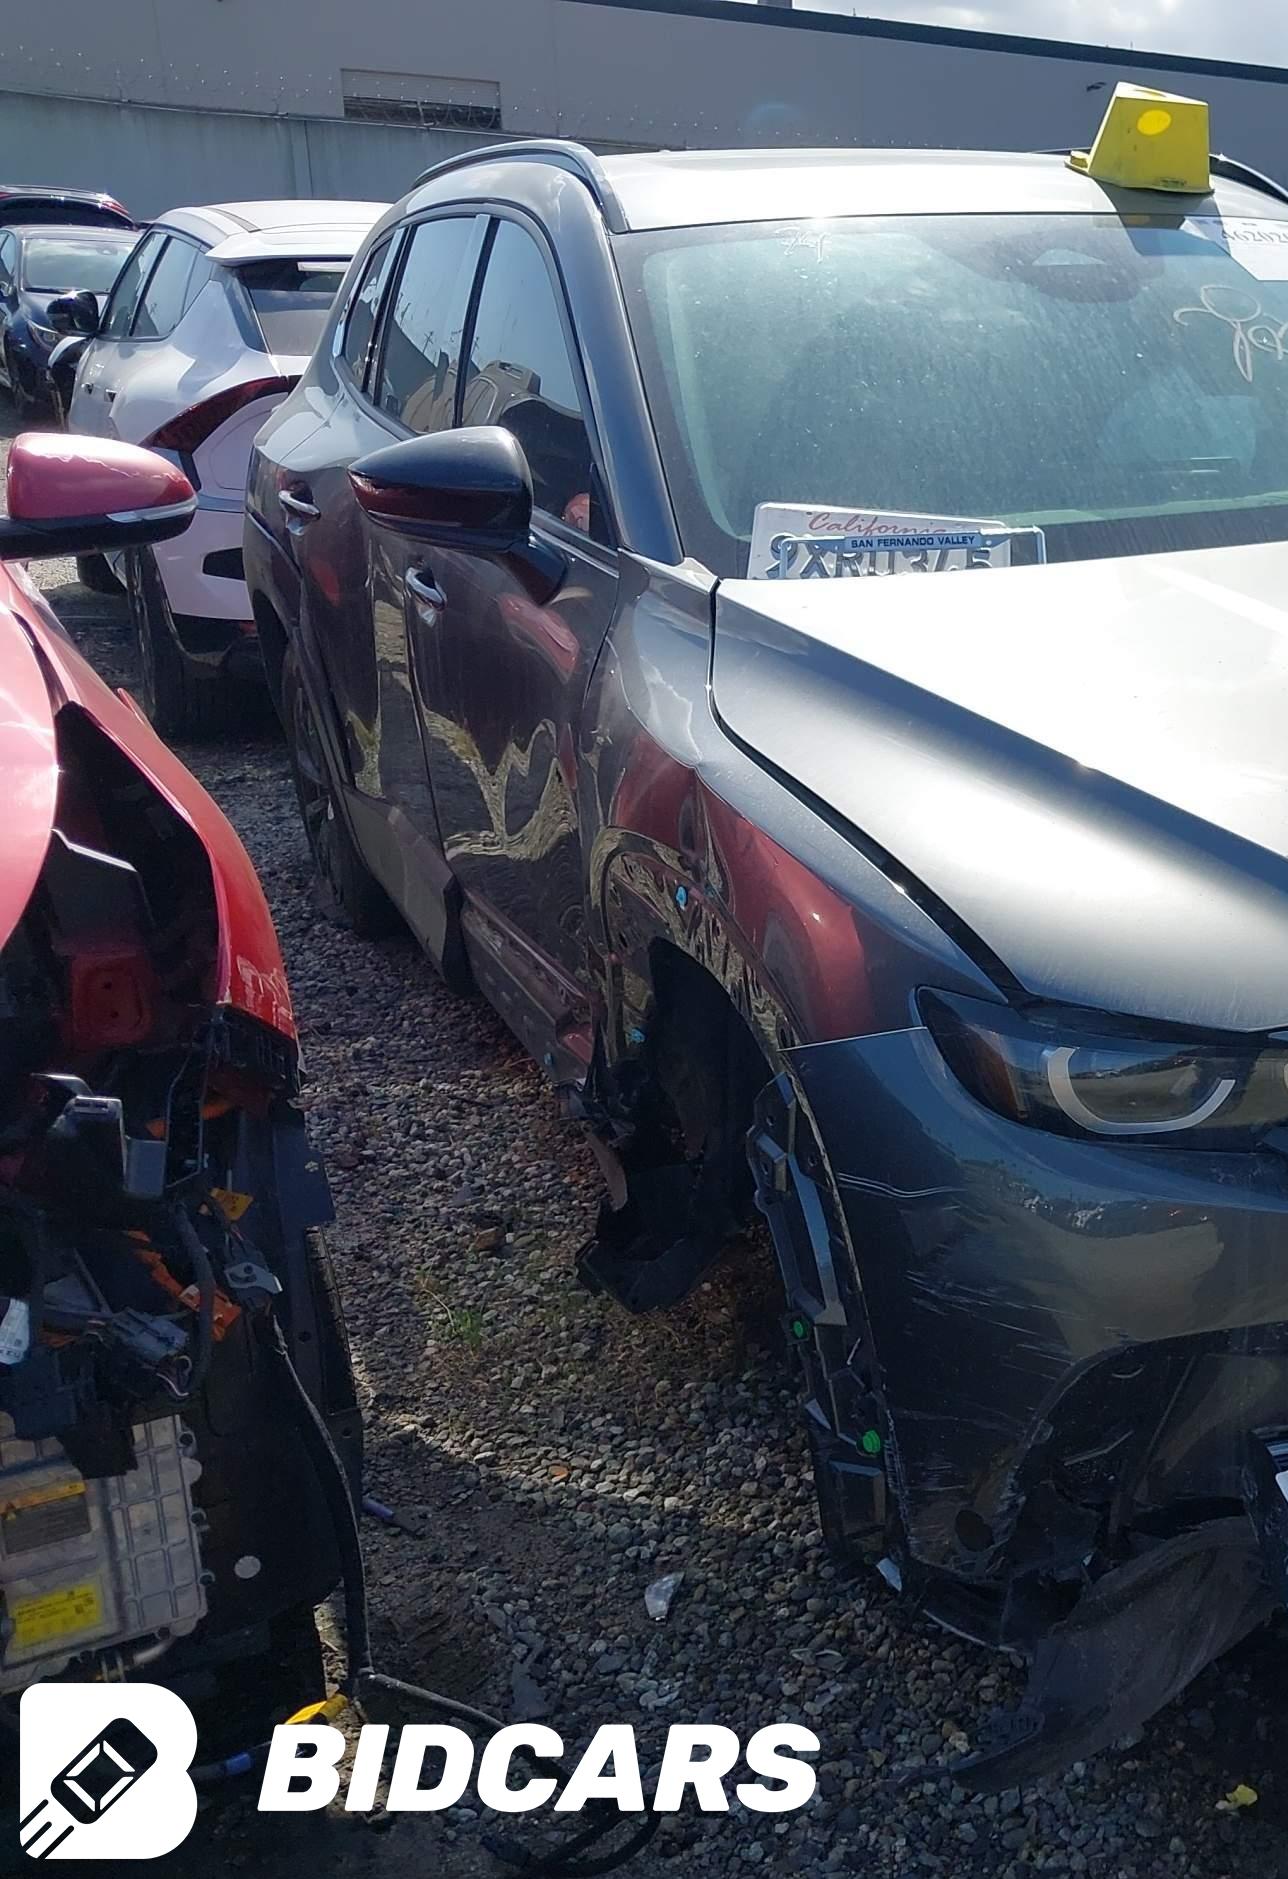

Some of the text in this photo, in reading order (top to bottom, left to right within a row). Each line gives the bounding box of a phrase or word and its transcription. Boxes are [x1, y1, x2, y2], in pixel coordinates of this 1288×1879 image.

[851, 535, 976, 549] SAN FERNANDO VALLEY
